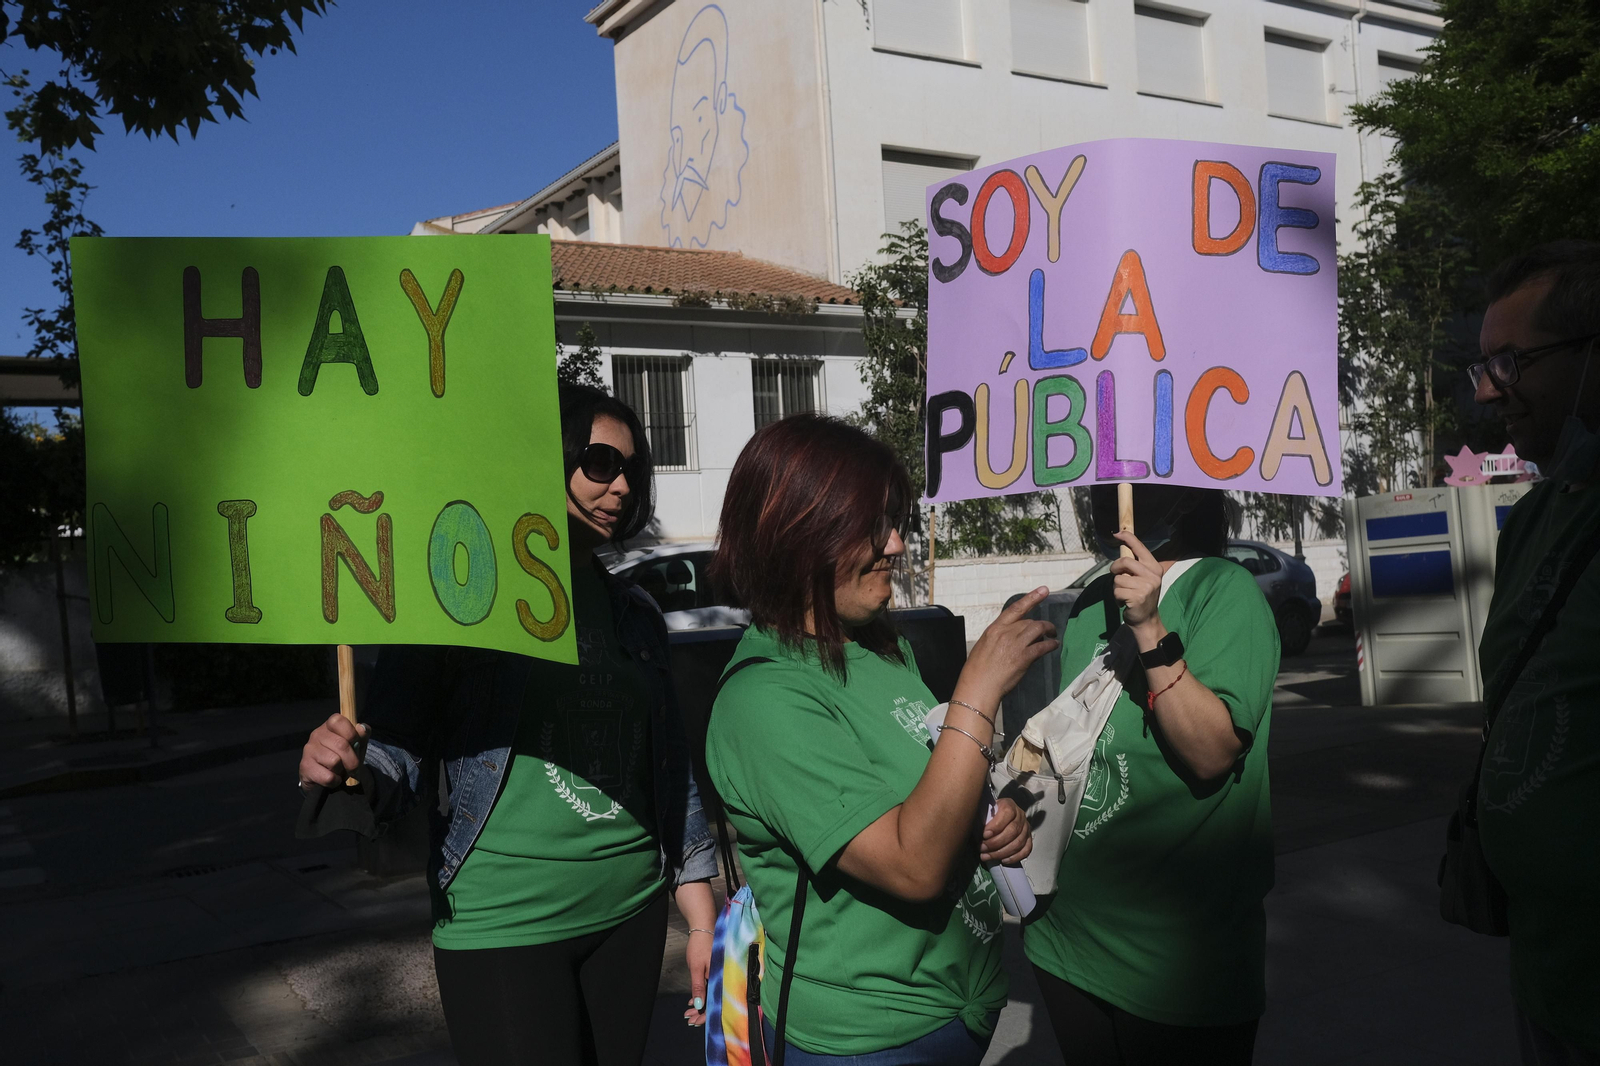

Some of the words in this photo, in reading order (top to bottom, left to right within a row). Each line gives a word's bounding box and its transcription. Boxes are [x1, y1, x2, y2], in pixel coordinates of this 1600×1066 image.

[930, 154, 1087, 283] SOY
[1191, 159, 1321, 275] DE
[183, 265, 464, 398] HAY
[1028, 249, 1166, 370] LA
[927, 351, 1333, 498] PÚBLICA
[92, 490, 571, 642] NIÑOS
[579, 673, 613, 685] CEIP
[580, 699, 612, 709] RONDA
